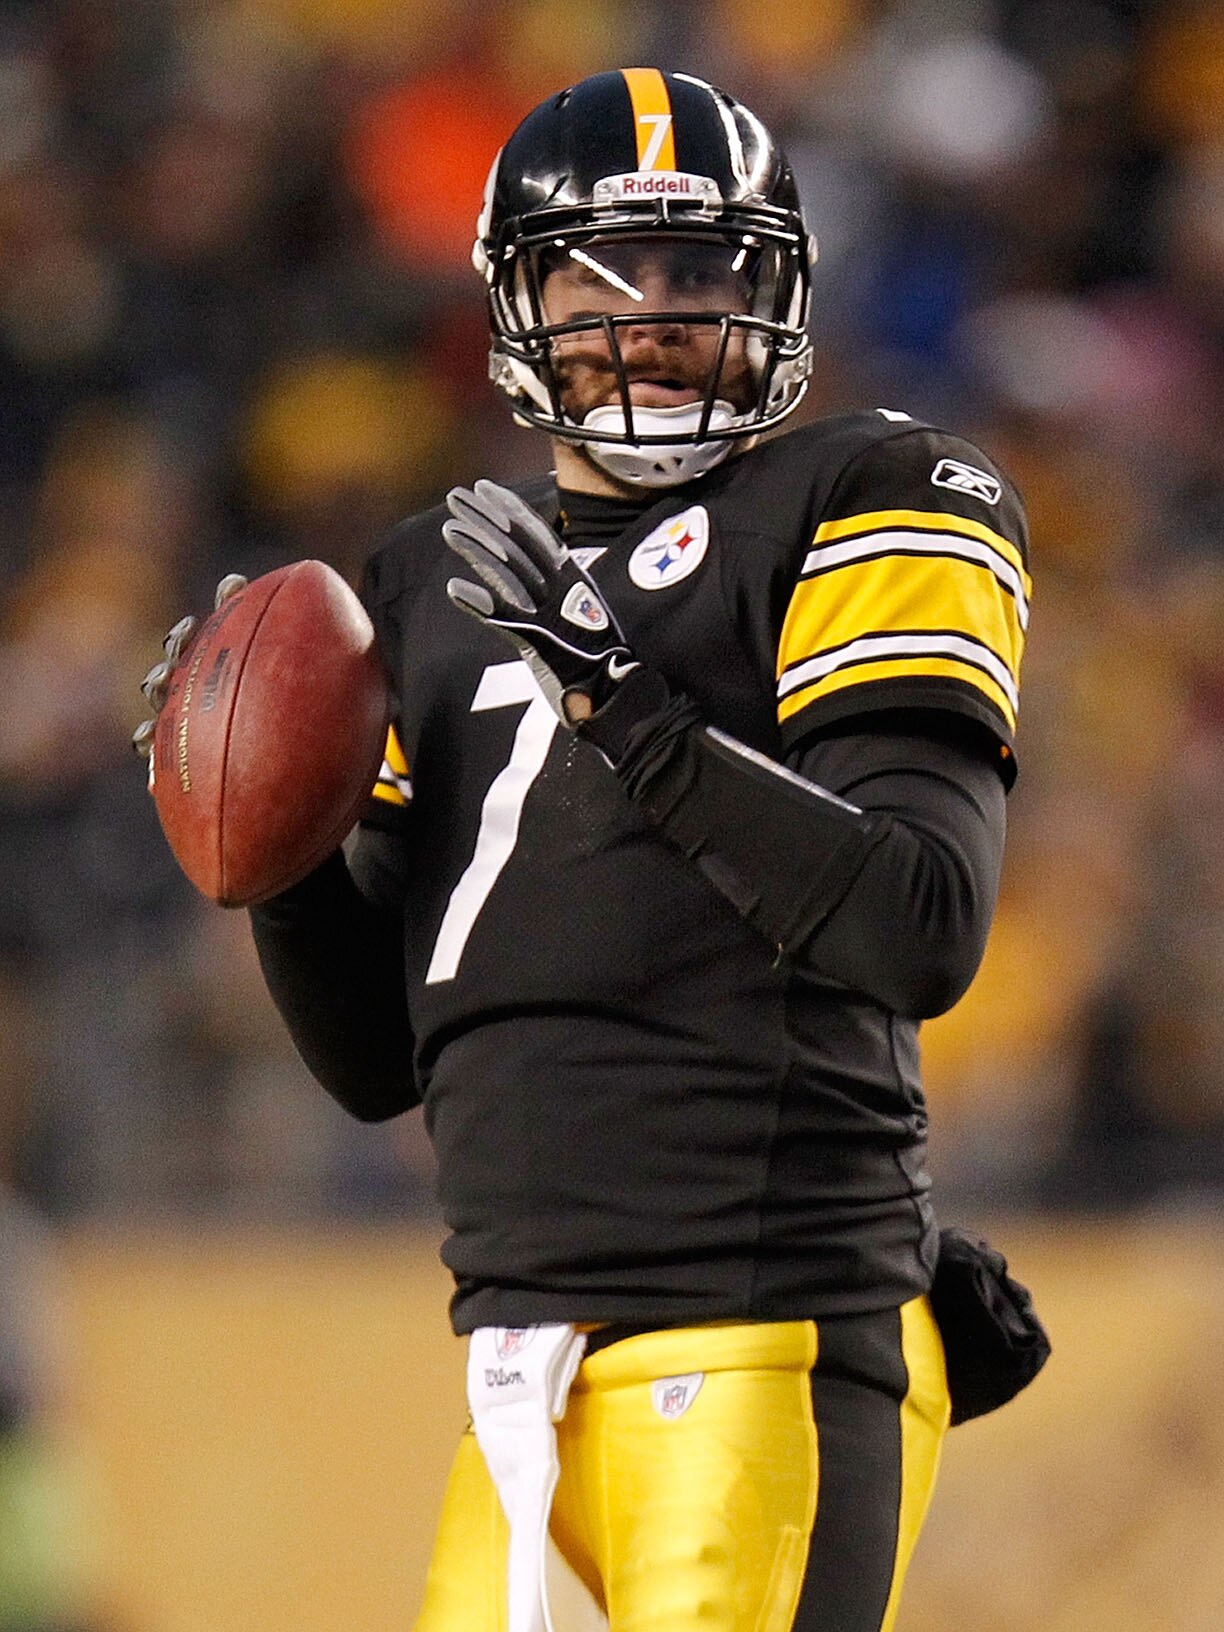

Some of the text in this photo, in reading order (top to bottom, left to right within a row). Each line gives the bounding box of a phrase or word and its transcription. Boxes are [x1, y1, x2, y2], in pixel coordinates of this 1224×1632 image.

[638, 114, 673, 171] 7
[623, 177, 690, 194] Riddell
[179, 717, 191, 793] NATIONAL
[425, 660, 560, 984] 7
